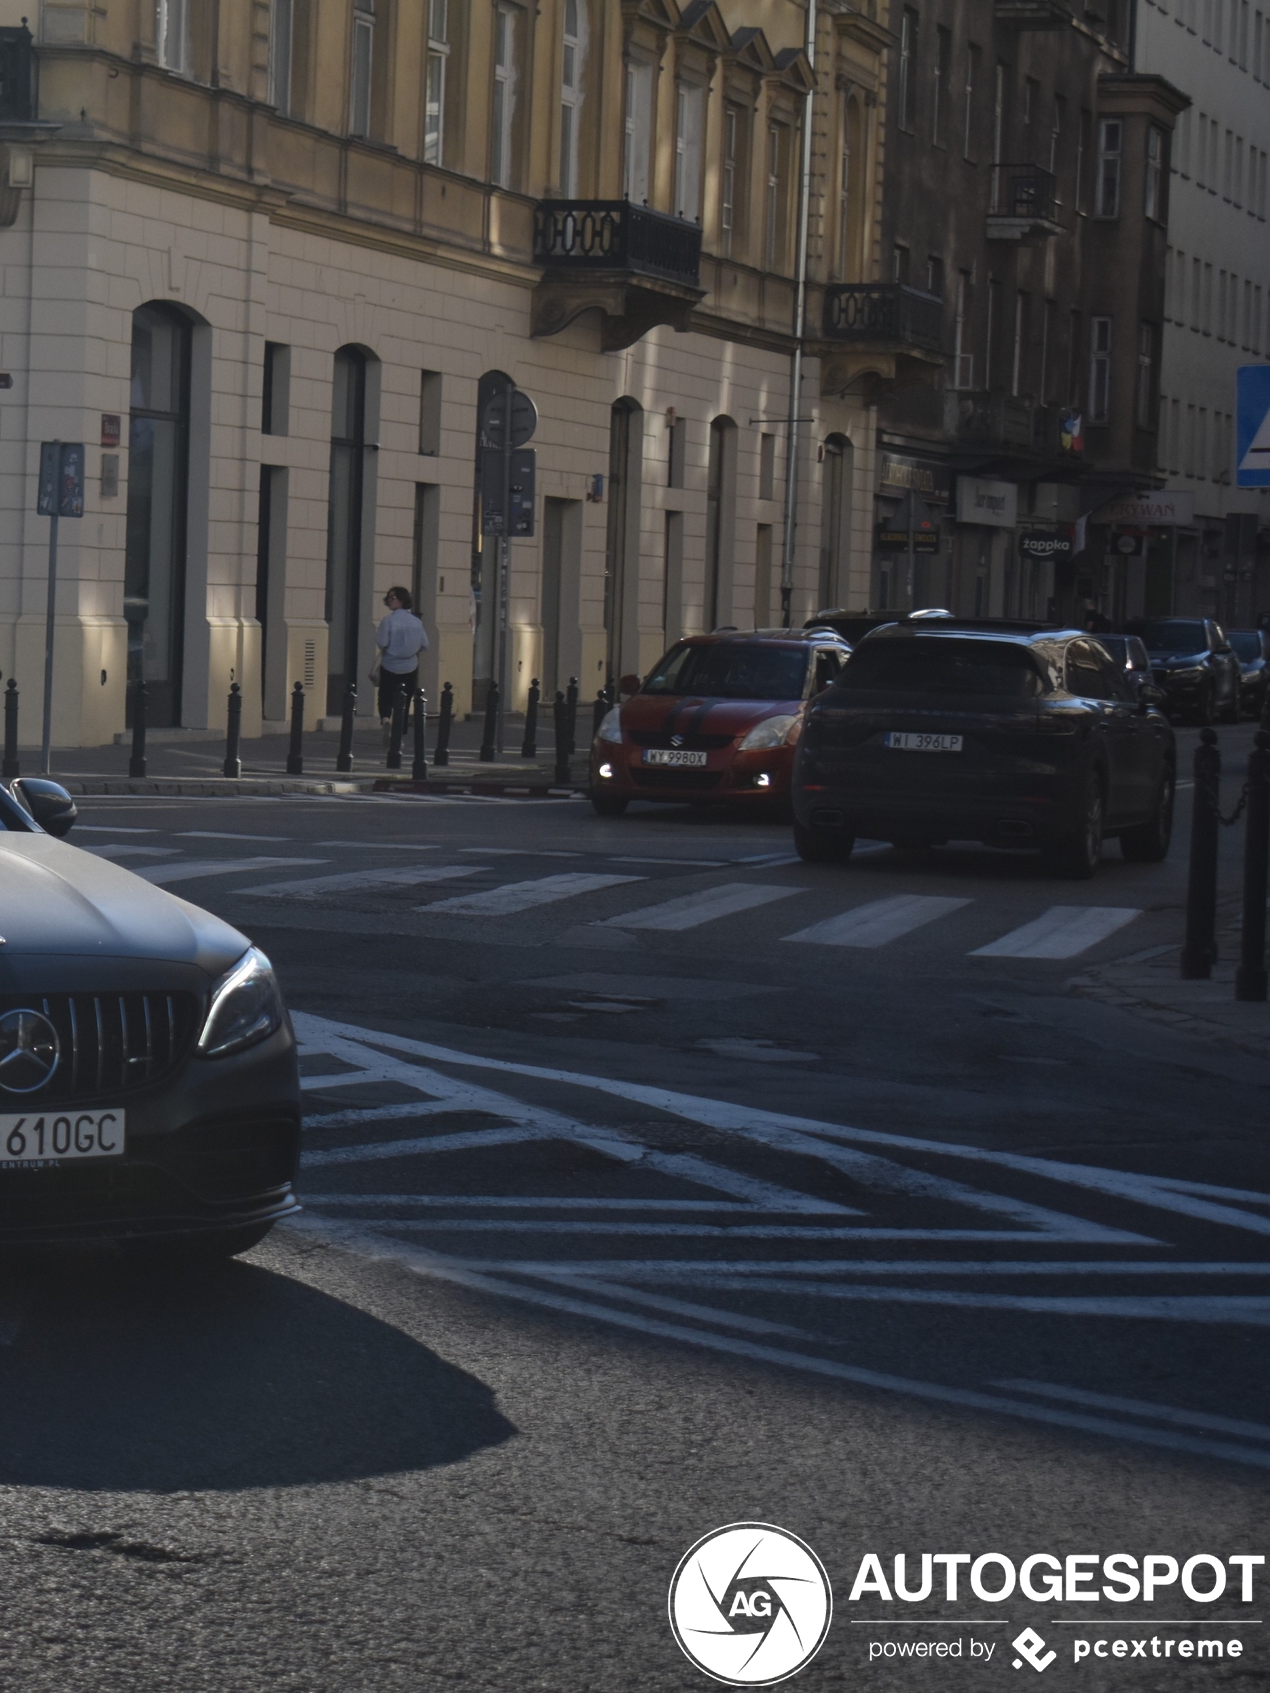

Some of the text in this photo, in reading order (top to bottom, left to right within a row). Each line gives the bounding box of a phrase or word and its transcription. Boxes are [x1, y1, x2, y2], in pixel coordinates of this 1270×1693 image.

[1023, 537, 1071, 552] żappka
[893, 733, 959, 750] WI 396LP
[650, 750, 704, 765] WY 9980X
[6, 1113, 117, 1156] 610GC
